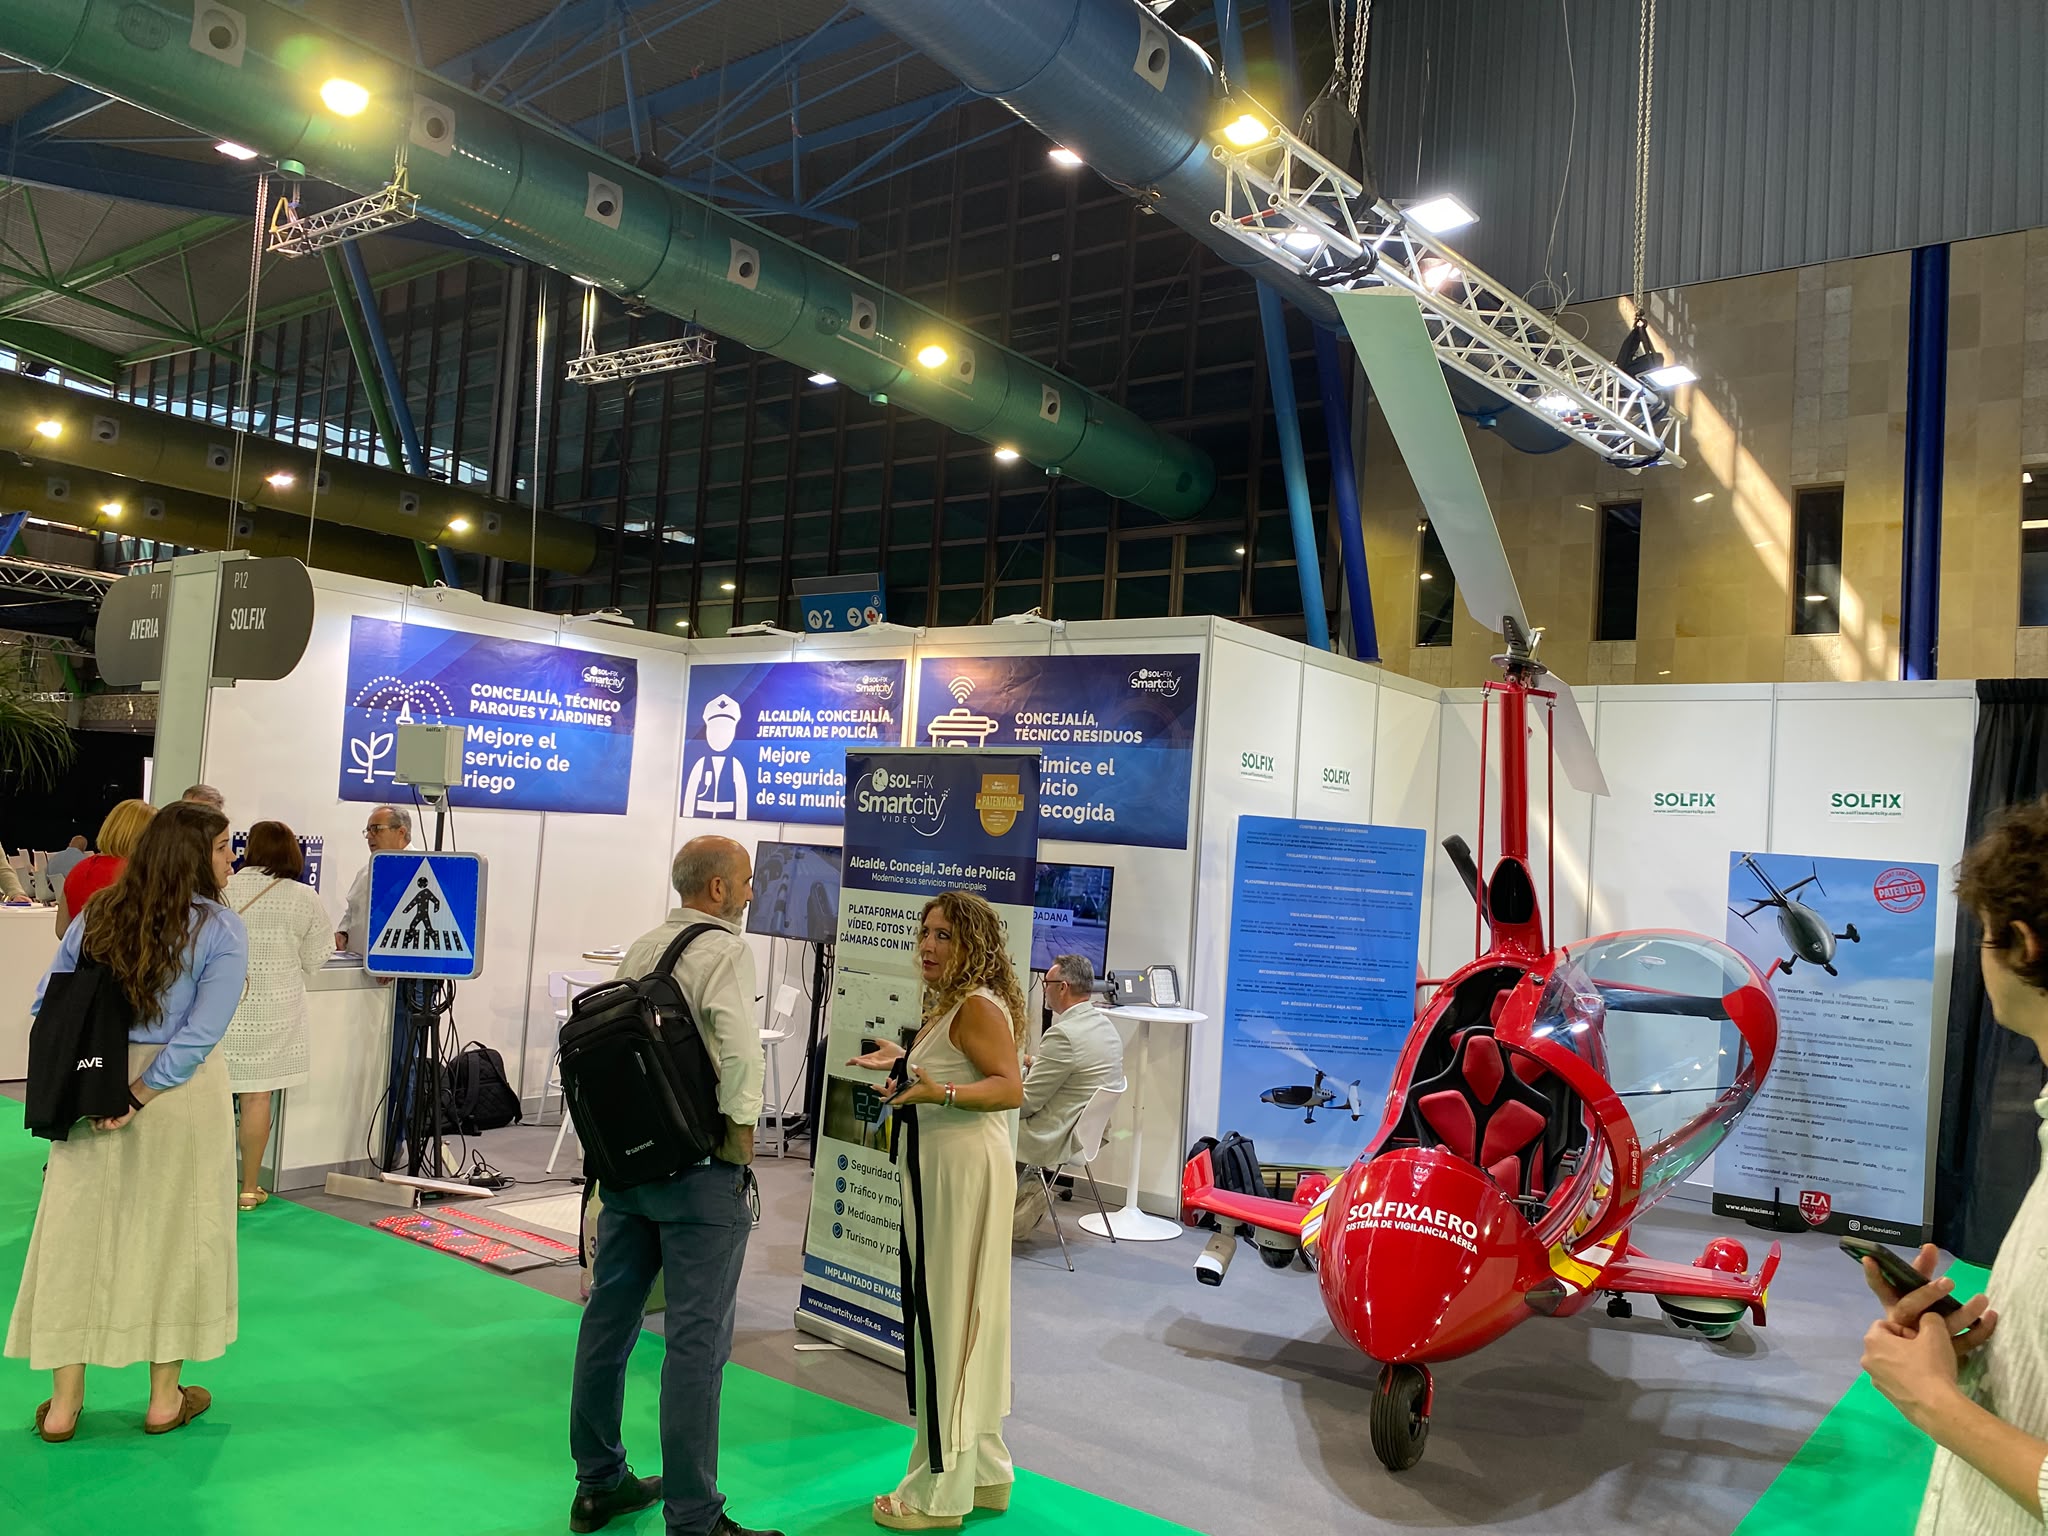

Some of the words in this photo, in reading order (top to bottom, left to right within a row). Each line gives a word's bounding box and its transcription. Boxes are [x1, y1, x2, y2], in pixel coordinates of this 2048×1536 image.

[234, 572, 248, 589] P12
[150, 584, 162, 600] P11
[130, 618, 159, 640] AYERIA
[230, 608, 266, 630] SOLFIX
[824, 610, 834, 628] 2
[1131, 677, 1181, 691] Smartcity
[470, 683, 562, 707] CONCEJALÍA,
[564, 693, 620, 713] TÉCNICO
[470, 700, 536, 719] PARQUES
[538, 707, 548, 720] Y
[550, 710, 612, 728] JARDINES
[758, 707, 814, 724] ALCALDÍA,
[816, 706, 894, 724] CONCEJALÍA,
[1015, 710, 1099, 728] CONCEJALÍA,
[466, 724, 534, 749] Mejore
[538, 732, 557, 750] el
[756, 725, 810, 738] JEFATURA
[813, 726, 828, 738] DE
[831, 722, 878, 738] POLICÍA
[1014, 726, 1070, 741] TÉCNICO
[1073, 730, 1143, 744] RESIDUOS
[465, 750, 541, 770] servicio
[546, 755, 570, 772] de
[759, 746, 810, 767] Mejore
[1040, 756, 1092, 775] imice
[1096, 758, 1115, 776] el
[1241, 752, 1274, 772] SOLFIX
[464, 770, 515, 794] riego
[757, 767, 772, 784] la
[774, 769, 846, 789] segurida
[889, 774, 934, 789] SOL-FIX
[1323, 768, 1350, 785] SOLFIX
[756, 788, 775, 806] de
[778, 793, 796, 806] su
[800, 790, 846, 808] munic
[858, 790, 946, 821] Smartcity
[982, 796, 1017, 807] PATENTADO
[1654, 792, 1716, 807] SOLFIX
[1831, 793, 1901, 808] SOLFIX
[882, 815, 916, 824] VIDEO
[1039, 803, 1115, 824] ecogida
[850, 856, 888, 871] Alcalde,
[889, 859, 935, 876] Concejal,
[938, 863, 962, 877] Jefe
[964, 866, 977, 878] de
[979, 867, 1016, 881] Policía
[872, 872, 904, 884] Modernice
[918, 877, 946, 888] servicios
[948, 881, 987, 891] municipales
[1878, 883, 1921, 898] PATENTED
[848, 904, 904, 919] PLATAFORMA
[906, 910, 922, 921] CLO
[1033, 911, 1068, 923] DADANA
[848, 917, 874, 932] VÍDEO,
[876, 922, 904, 934] FOTOS
[906, 926, 912, 935] Y
[840, 931, 878, 947] CÁMARAS
[880, 938, 899, 949] CON
[901, 941, 916, 951] INT
[76, 1056, 103, 1070] AVE
[851, 1159, 892, 1181] Seguridad
[849, 1182, 876, 1200] Tráfico
[878, 1194, 883, 1204] y
[885, 1196, 902, 1208] mov
[1802, 1193, 1828, 1207] ELA
[847, 1205, 900, 1232] Medioambien
[1348, 1202, 1478, 1239] SOLFIXAERO
[1345, 1220, 1379, 1232] SISTEMA
[1380, 1220, 1392, 1229] DE
[1394, 1220, 1448, 1240] VIGILANCIA
[1450, 1234, 1478, 1254] AÉREA
[1862, 1224, 1901, 1236] @elaaviation
[845, 1228, 877, 1249] Turismo
[879, 1242, 885, 1253] y
[886, 1244, 900, 1257] pro
[824, 1266, 872, 1290] IMPLANTADO
[873, 1283, 884, 1294] EN
[885, 1284, 901, 1302] MÁS
[808, 1296, 882, 1332] www.smartcity.sol-fix.es
